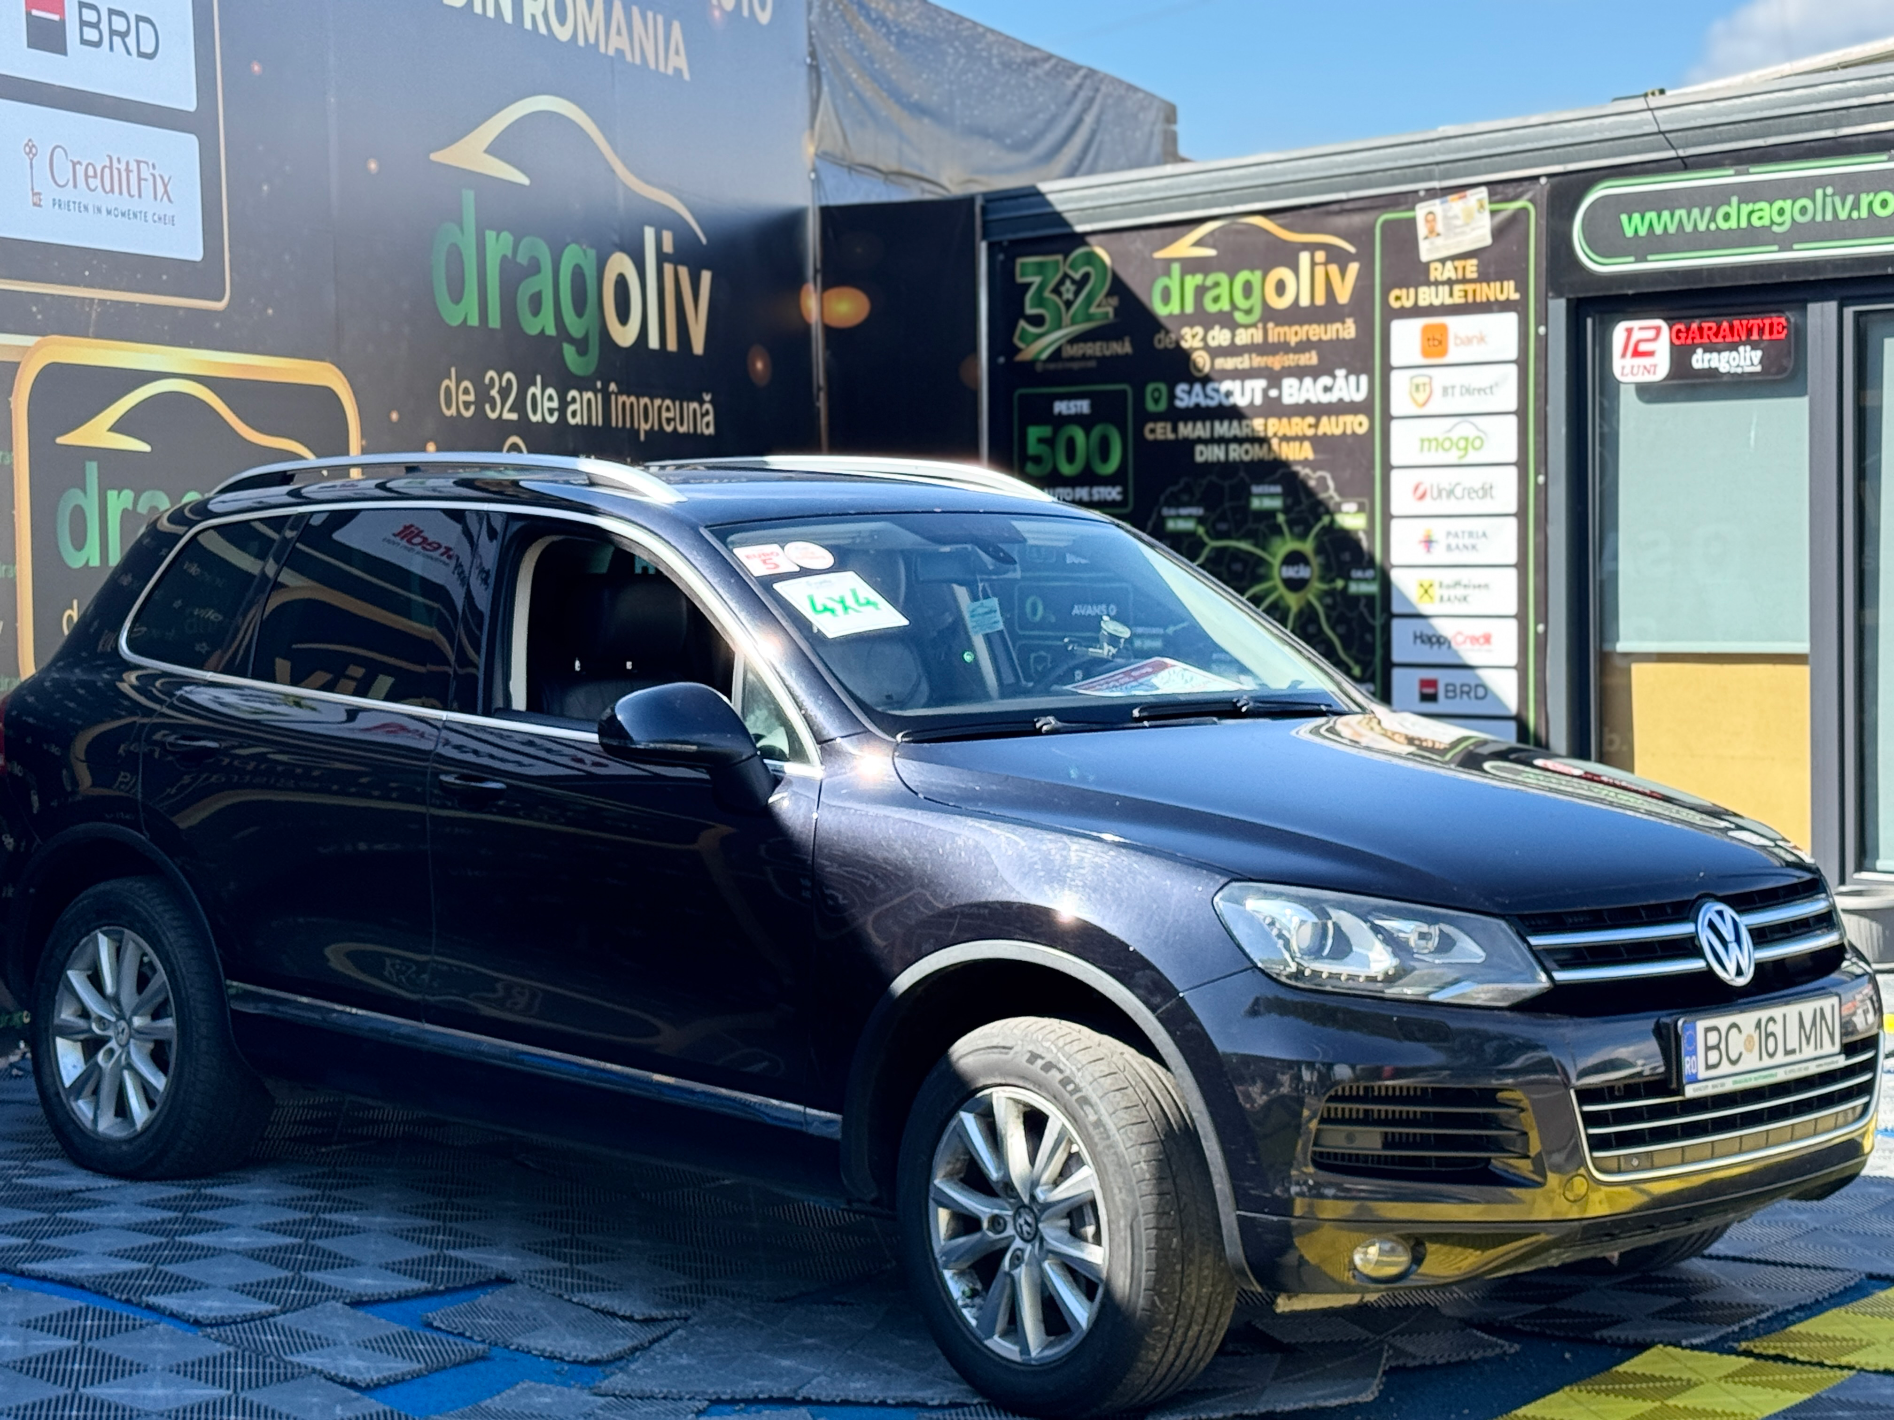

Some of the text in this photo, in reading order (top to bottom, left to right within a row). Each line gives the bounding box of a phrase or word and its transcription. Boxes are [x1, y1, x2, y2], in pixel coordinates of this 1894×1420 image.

[78, 2, 160, 61] BRD
[48, 144, 174, 204] CreditFix
[51, 198, 177, 227] PRIETEN IN MOMENTE CHEIE
[1620, 185, 1894, 239] www.dragoliv.ro
[431, 188, 712, 377] dragoliv
[1429, 259, 1479, 282] RATE
[1013, 246, 1112, 351] 32
[1151, 250, 1360, 325] dragoliv
[1388, 280, 1521, 309] CU BULETINUL
[1154, 318, 1357, 349] de 32 de ani împreună
[1453, 331, 1488, 347] bank
[1620, 316, 1788, 360] 12 GARANTIE
[1621, 364, 1658, 377] LUNI
[1691, 346, 1763, 374] dragoliv
[1174, 378, 1268, 409] SASCUT
[1281, 368, 1369, 405] BACĂU
[1441, 385, 1457, 398] BT
[439, 367, 715, 442] de 32 de ani împreună
[1053, 399, 1092, 416] PESTE
[1143, 413, 1370, 441] CEL MAI MARE PARC AUTO
[1024, 422, 1123, 478] 500
[1194, 443, 1226, 463] DIN
[1419, 435, 1485, 460] mogo
[1429, 482, 1494, 501] UniCredit
[1445, 531, 1488, 541] PATRIA
[1445, 543, 1479, 553] BANK
[759, 558, 781, 571] 5
[1443, 682, 1489, 701] BRD
[1703, 1003, 1836, 1073] BC 16 LMN
[1684, 1055, 1697, 1076] RO
